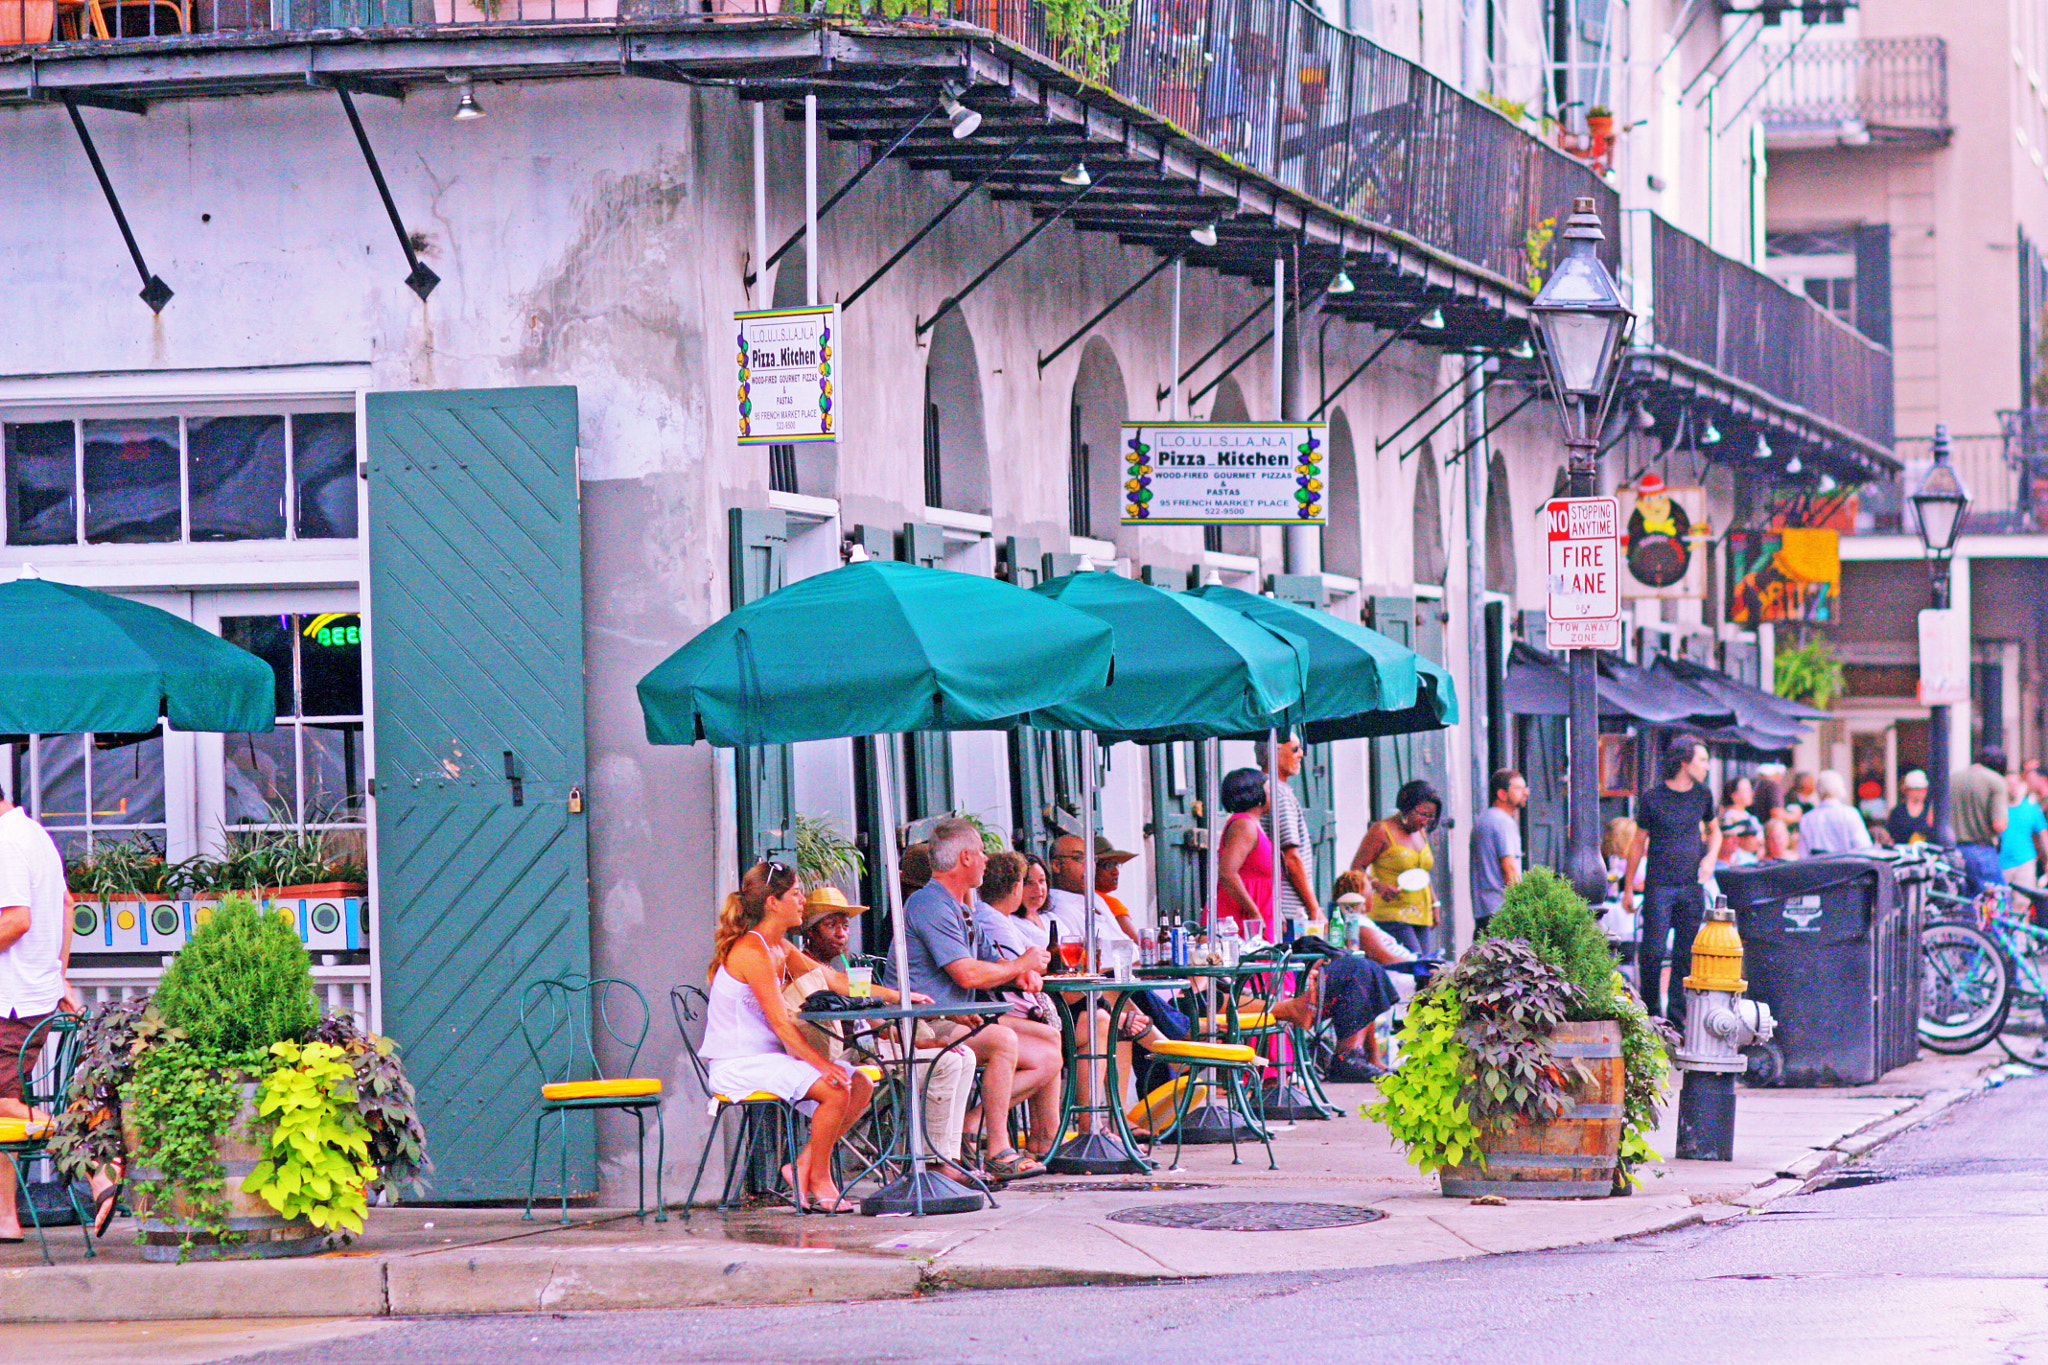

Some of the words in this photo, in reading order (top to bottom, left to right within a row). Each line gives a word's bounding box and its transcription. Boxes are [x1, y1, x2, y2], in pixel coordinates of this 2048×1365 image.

[752, 376, 777, 385] WOOD-FIRED
[779, 374, 800, 383] GOURMET
[802, 373, 818, 382] PIZZAS
[776, 397, 793, 405] PASTAS
[761, 411, 780, 420] FRENCH
[780, 410, 800, 419] MARKET
[801, 409, 817, 418] PLACE
[1548, 510, 1569, 533] NO
[1571, 504, 1611, 520] STOPPING
[1571, 520, 1612, 536] ANYTIME
[1563, 545, 1603, 568] FIRE
[1559, 623, 1579, 632] TOW
[1584, 622, 1611, 631] AWAY
[317, 625, 361, 646] BEE
[1570, 633, 1597, 642] ZONE
